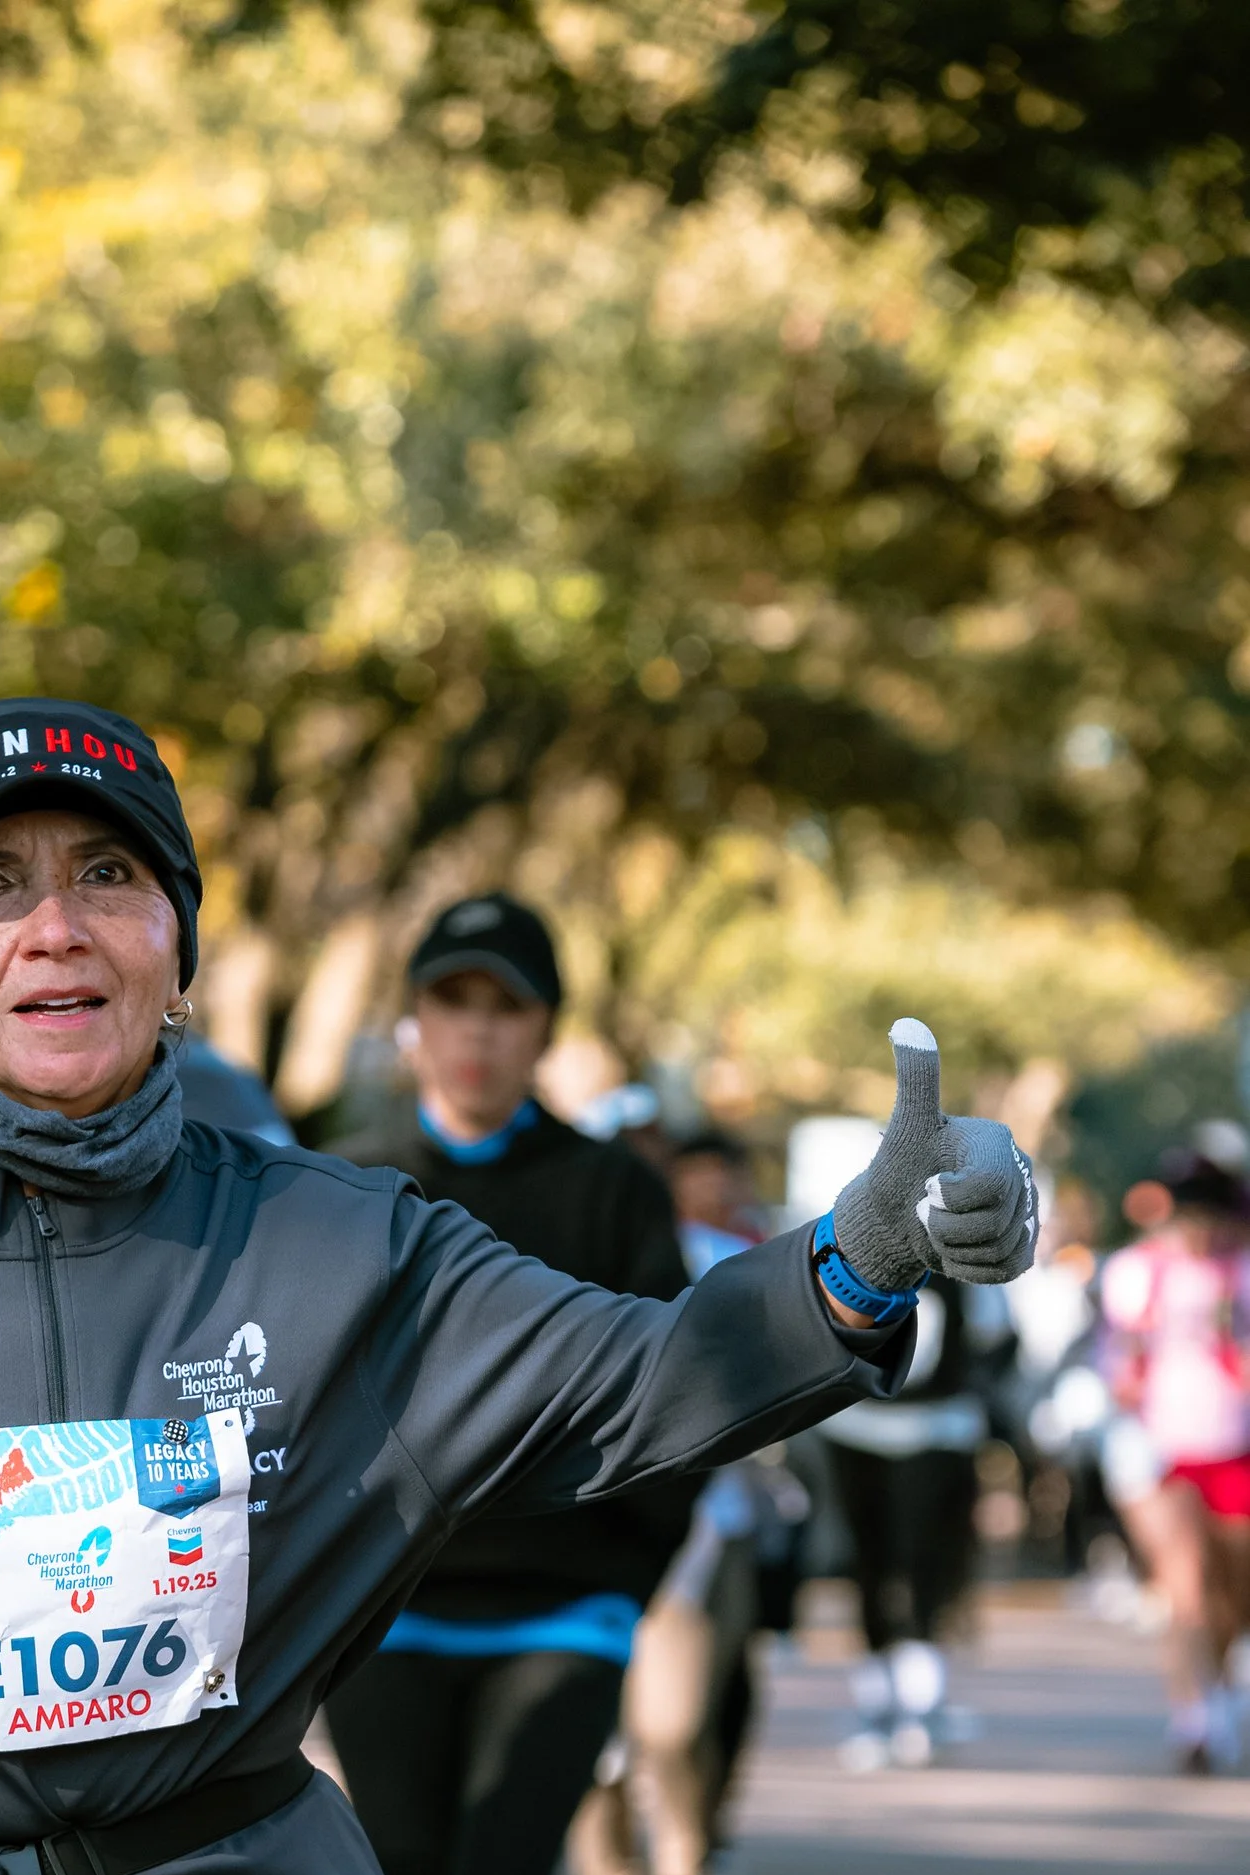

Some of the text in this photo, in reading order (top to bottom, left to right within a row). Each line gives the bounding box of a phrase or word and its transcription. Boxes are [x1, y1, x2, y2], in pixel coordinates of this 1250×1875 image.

[61, 763, 102, 780] 2024
[163, 1358, 223, 1379] Chevron
[183, 1374, 244, 1396] Houston
[203, 1386, 276, 1412] Marathon
[144, 1440, 207, 1462] LEGACY
[146, 1462, 209, 1483] 10 YEARS
[166, 1526, 202, 1537] Chevron
[27, 1552, 75, 1566] Chevron
[40, 1563, 90, 1578] Houston
[55, 1575, 113, 1591] Marathon
[152, 1571, 217, 1596] 1.19.25
[8, 1689, 152, 1735] AMPARO
